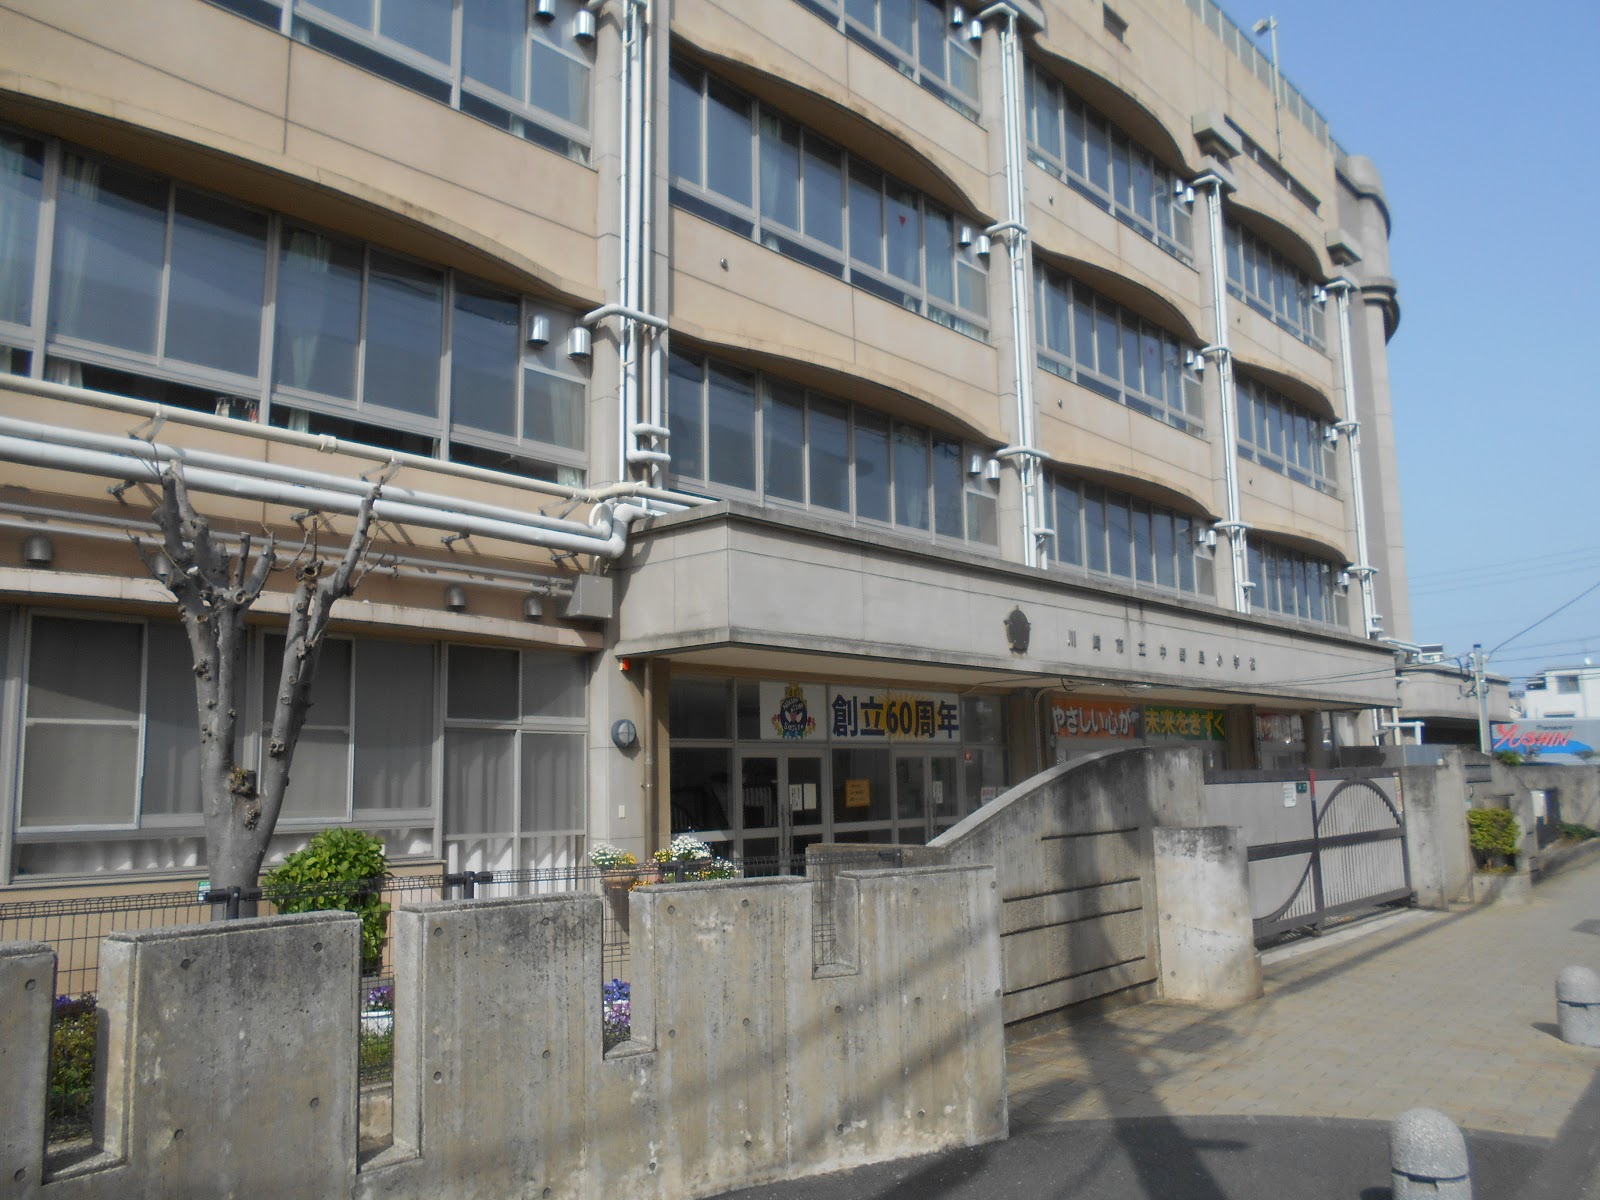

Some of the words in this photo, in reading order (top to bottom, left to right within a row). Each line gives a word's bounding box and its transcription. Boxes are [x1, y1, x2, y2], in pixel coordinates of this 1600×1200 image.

[832, 695, 959, 739] 創立60周年
[1052, 704, 1131, 735] やさしい心が
